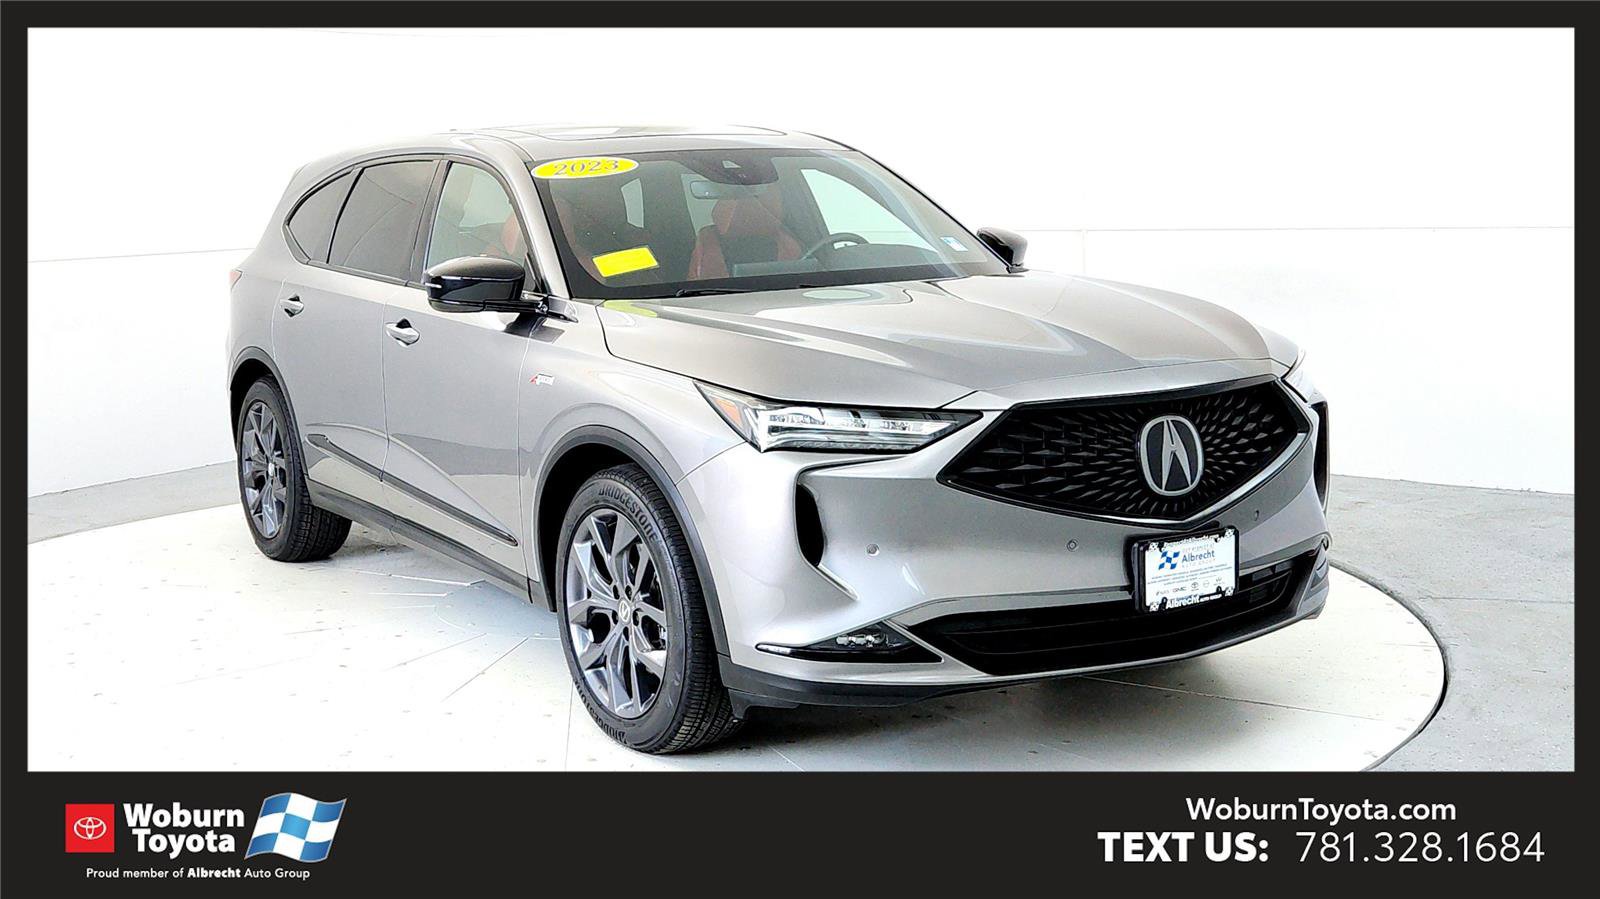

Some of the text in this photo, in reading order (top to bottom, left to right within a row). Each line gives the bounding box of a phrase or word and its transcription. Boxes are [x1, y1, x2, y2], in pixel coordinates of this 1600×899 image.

[554, 160, 619, 176] 2023
[598, 485, 660, 542] BRIDGESTONE
[1181, 550, 1216, 563] Albrecht
[1165, 594, 1200, 610] Albrecht
